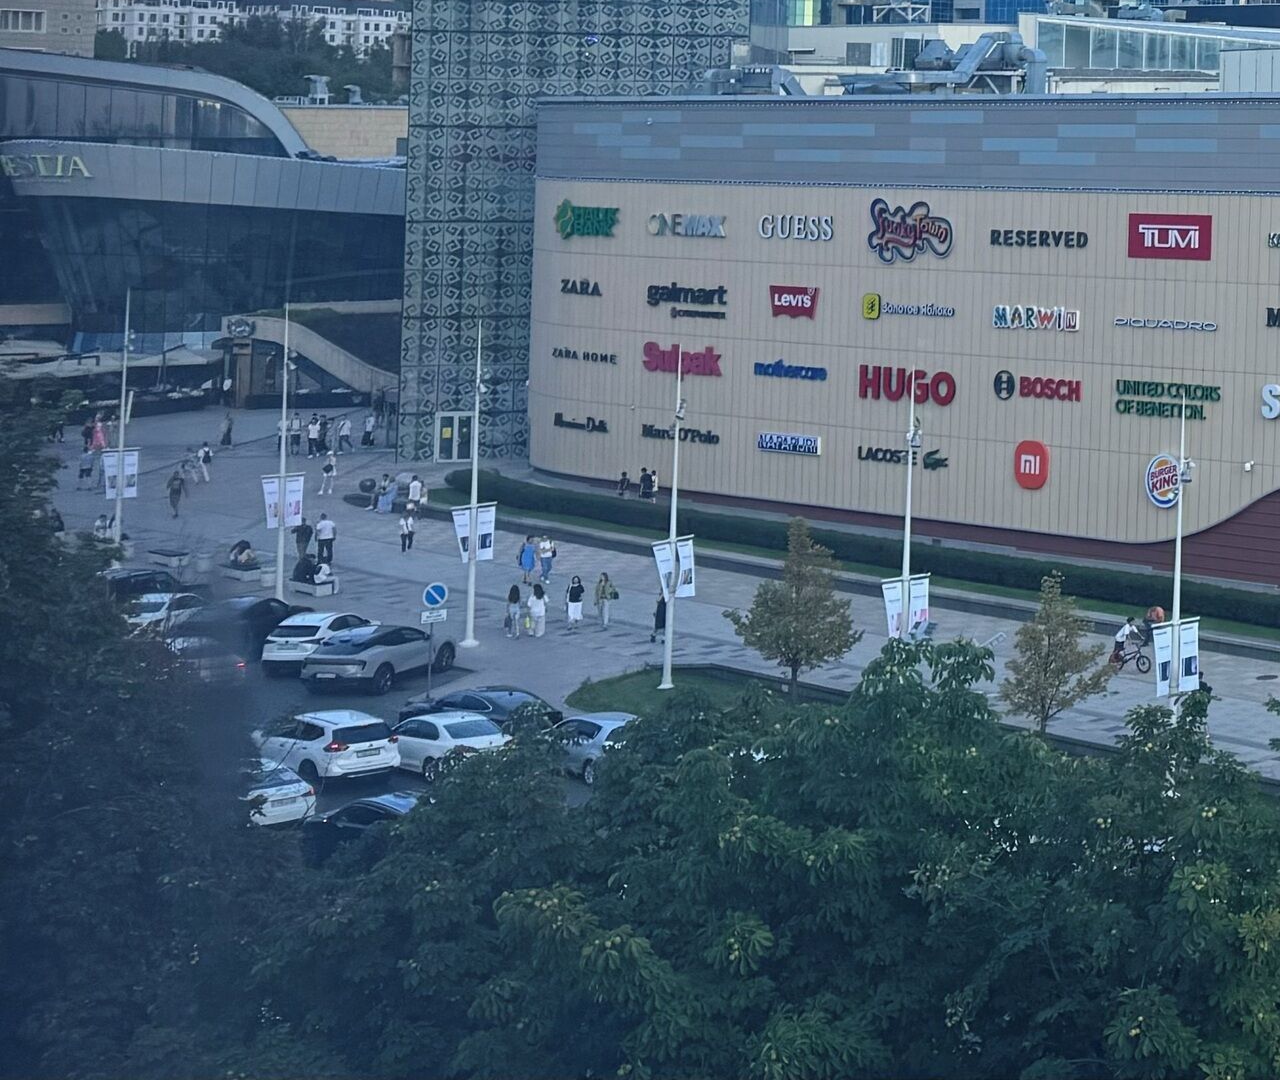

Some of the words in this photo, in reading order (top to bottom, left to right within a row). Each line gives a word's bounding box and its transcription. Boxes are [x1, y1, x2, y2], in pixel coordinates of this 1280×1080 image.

[758, 214, 834, 241] GUESS
[1139, 224, 1200, 249] TUMI
[990, 229, 1089, 248] RESERVED
[561, 279, 602, 297] ZARA
[552, 347, 578, 360] ZARA
[582, 351, 618, 365] HOME
[858, 364, 956, 406] HUGO
[1019, 376, 1082, 402] BOSCH
[1115, 379, 1165, 399] UNITED
[1166, 383, 1221, 402] COLORS
[1115, 398, 1135, 415] OF
[1150, 464, 1178, 481] BURGER
[1151, 473, 1179, 493] KING
